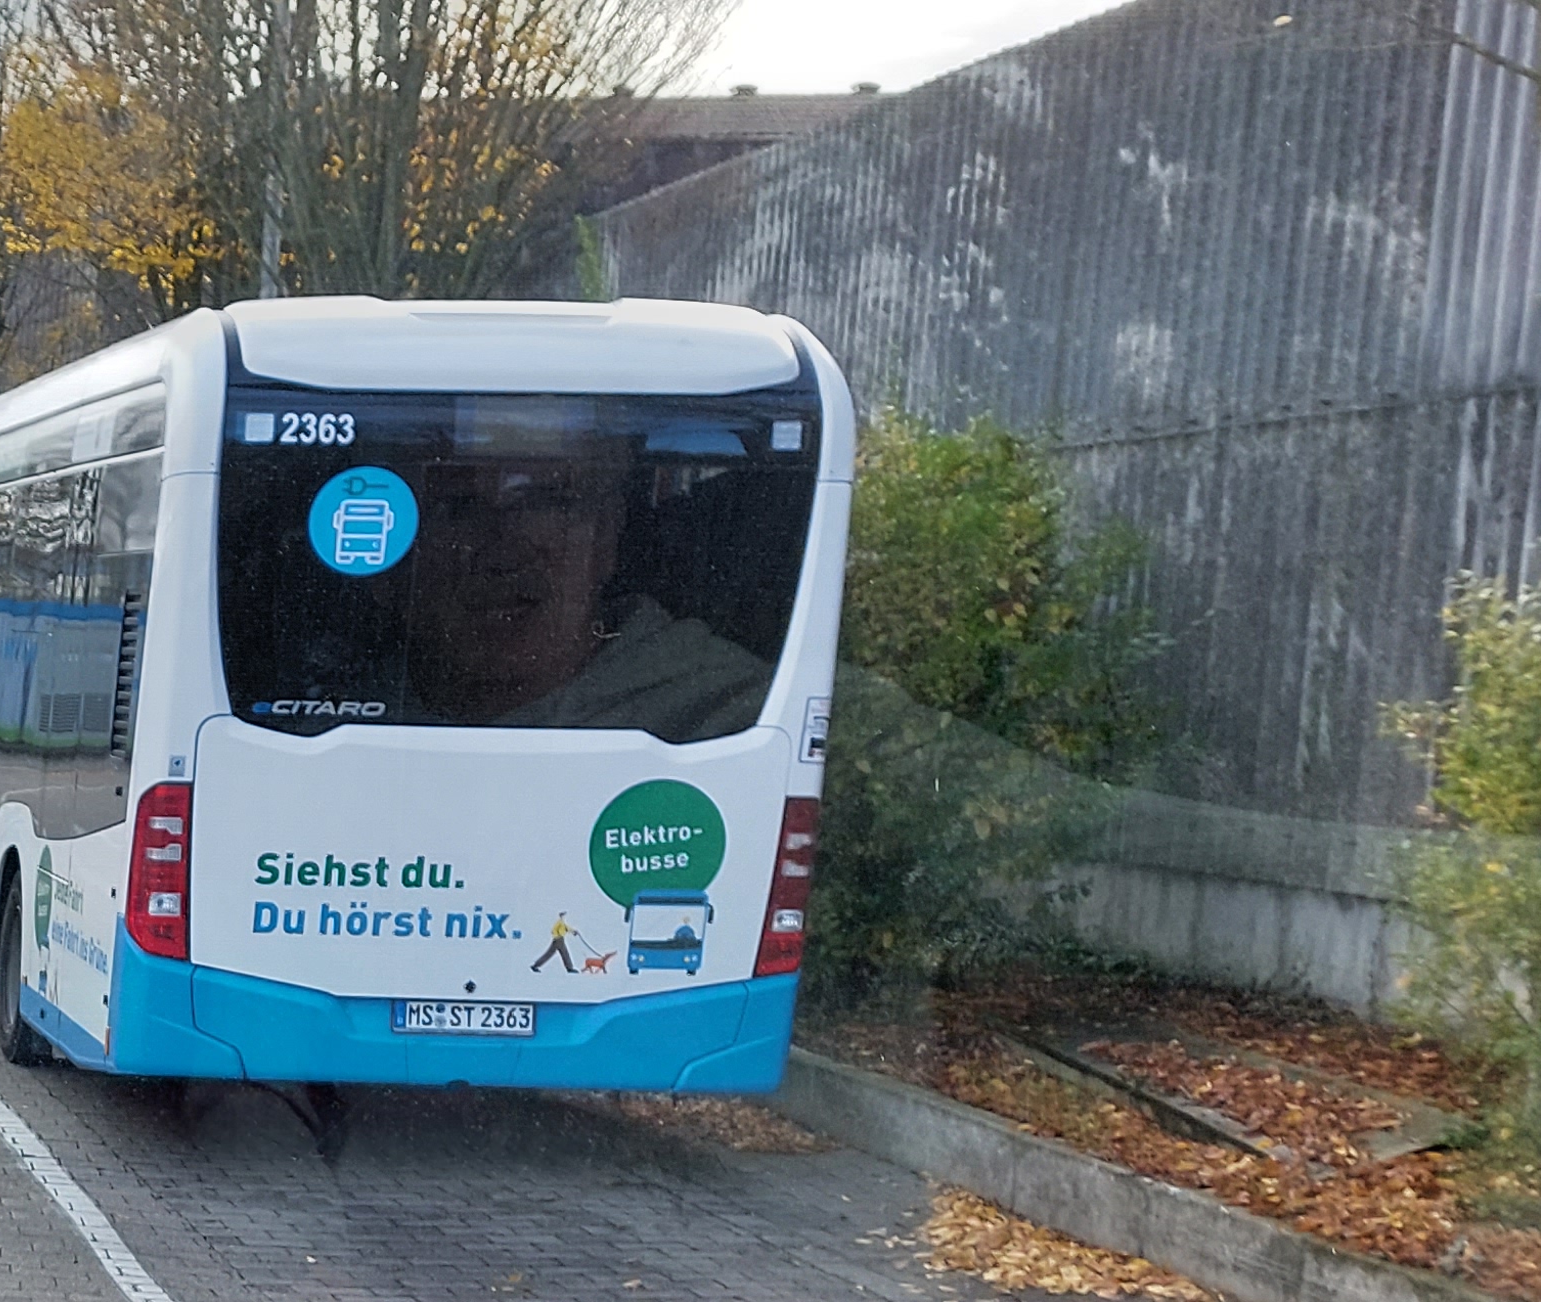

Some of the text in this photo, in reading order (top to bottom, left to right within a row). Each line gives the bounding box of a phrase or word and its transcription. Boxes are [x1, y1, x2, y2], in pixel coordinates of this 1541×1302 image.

[280, 412, 356, 445] 2363
[605, 825, 703, 849] Elektro-
[254, 852, 465, 889] Siehst du.
[620, 852, 690, 873] busse
[252, 901, 523, 940] Du hörst nix.
[408, 1004, 531, 1029] MS ST 2363
